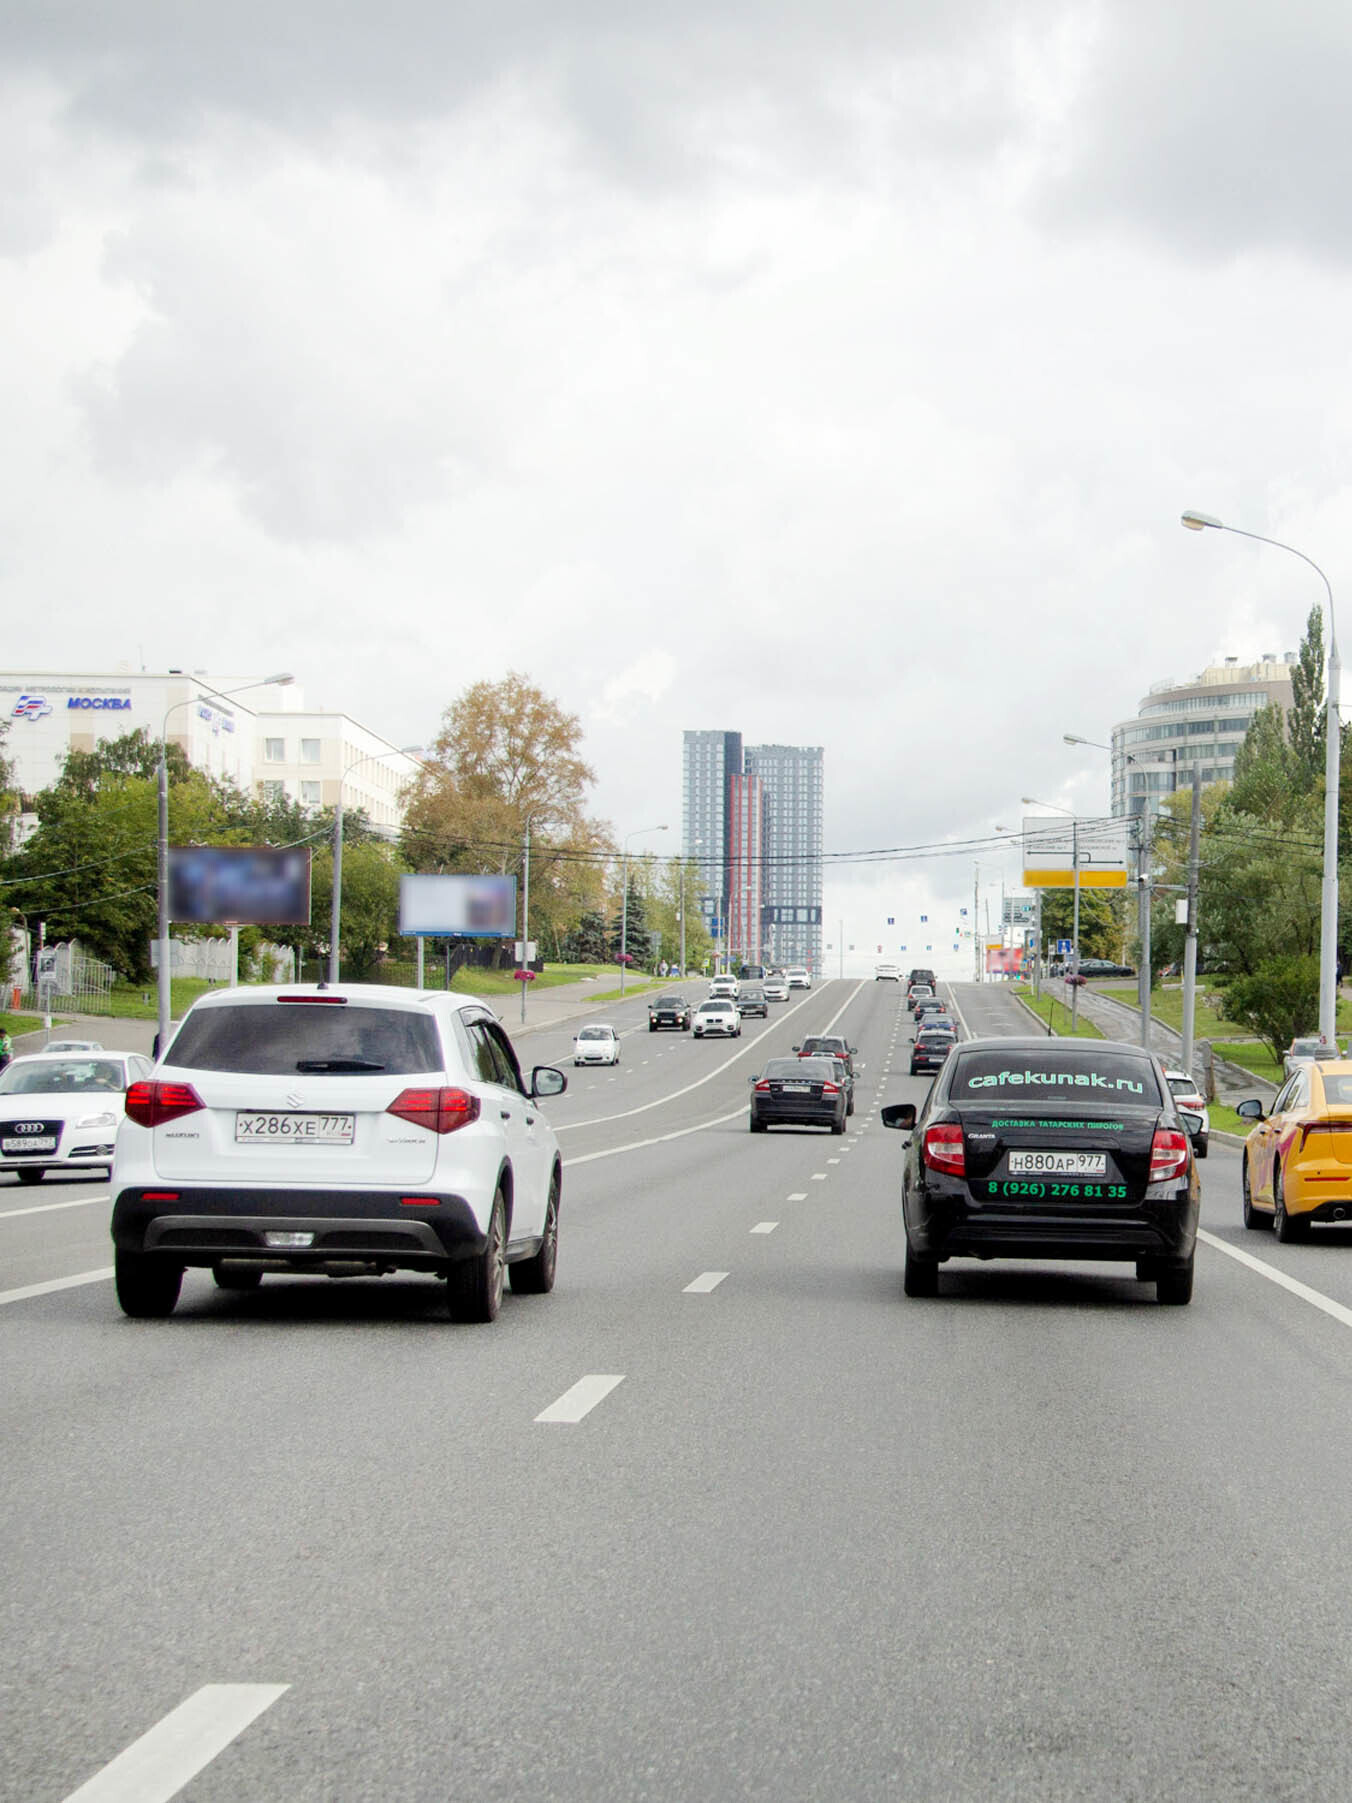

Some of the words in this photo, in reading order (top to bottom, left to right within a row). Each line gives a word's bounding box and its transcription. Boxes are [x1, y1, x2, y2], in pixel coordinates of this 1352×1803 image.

[67, 697, 132, 710] МОСКВА
[968, 1071, 1143, 1094] cafekunak.ru
[992, 1120, 1036, 1128] ДОСТАВКА
[1039, 1121, 1084, 1129] ТАТАРСКИХ
[1088, 1122, 1125, 1131] ПИРОГОВ
[988, 1181, 997, 1193] 8
[1003, 1181, 1045, 1196] (926)
[1050, 1184, 1080, 1196] 276
[1084, 1185, 1103, 1197] 81
[1108, 1186, 1127, 1198] 35
